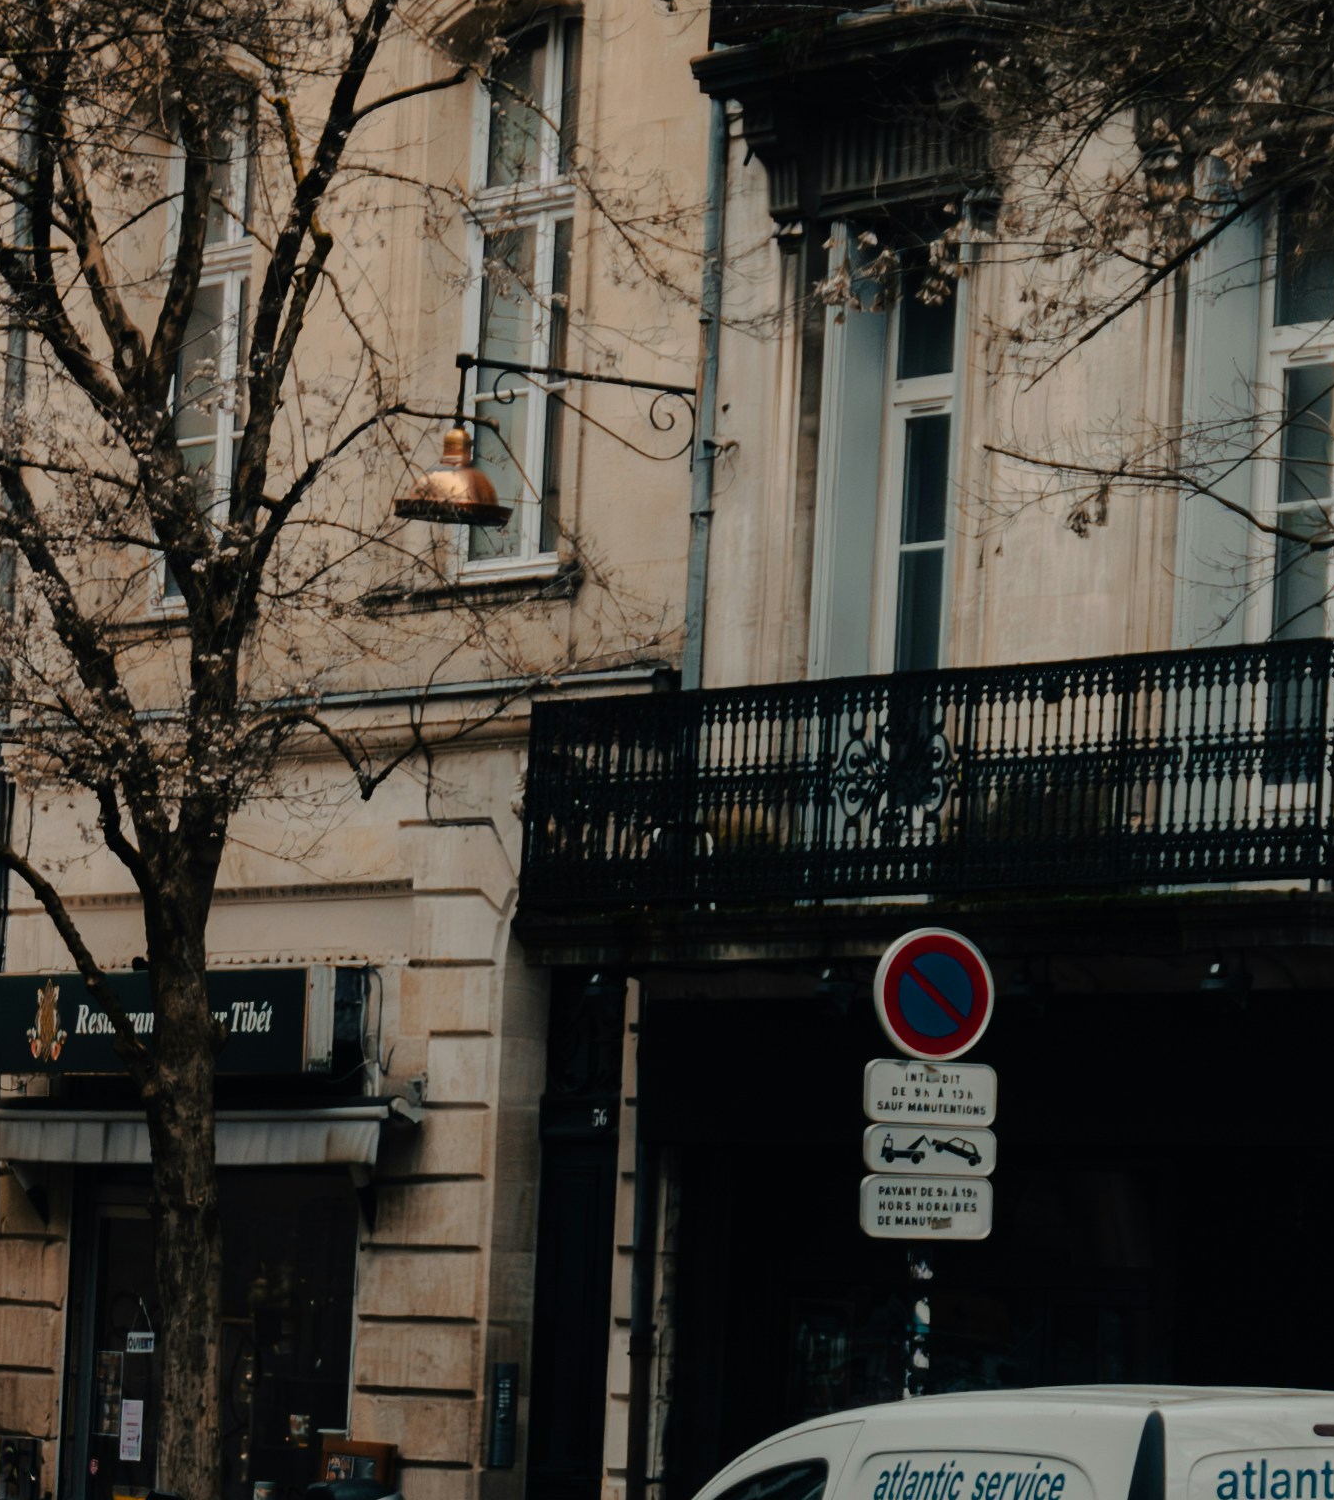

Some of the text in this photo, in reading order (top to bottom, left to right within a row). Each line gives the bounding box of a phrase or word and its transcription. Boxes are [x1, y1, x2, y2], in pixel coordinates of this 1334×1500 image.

[230, 1001, 273, 1033] Tibét
[905, 1072, 961, 1084] INTDIT
[892, 1086, 906, 1096] DE
[877, 1101, 986, 1115] SAUF MANUTENTIONS
[591, 1108, 608, 1127] 56
[878, 1186, 917, 1196] PAYANT
[921, 1187, 933, 1197] DE
[879, 1201, 977, 1212] HORS HORAIRES
[877, 1216, 891, 1225] DE
